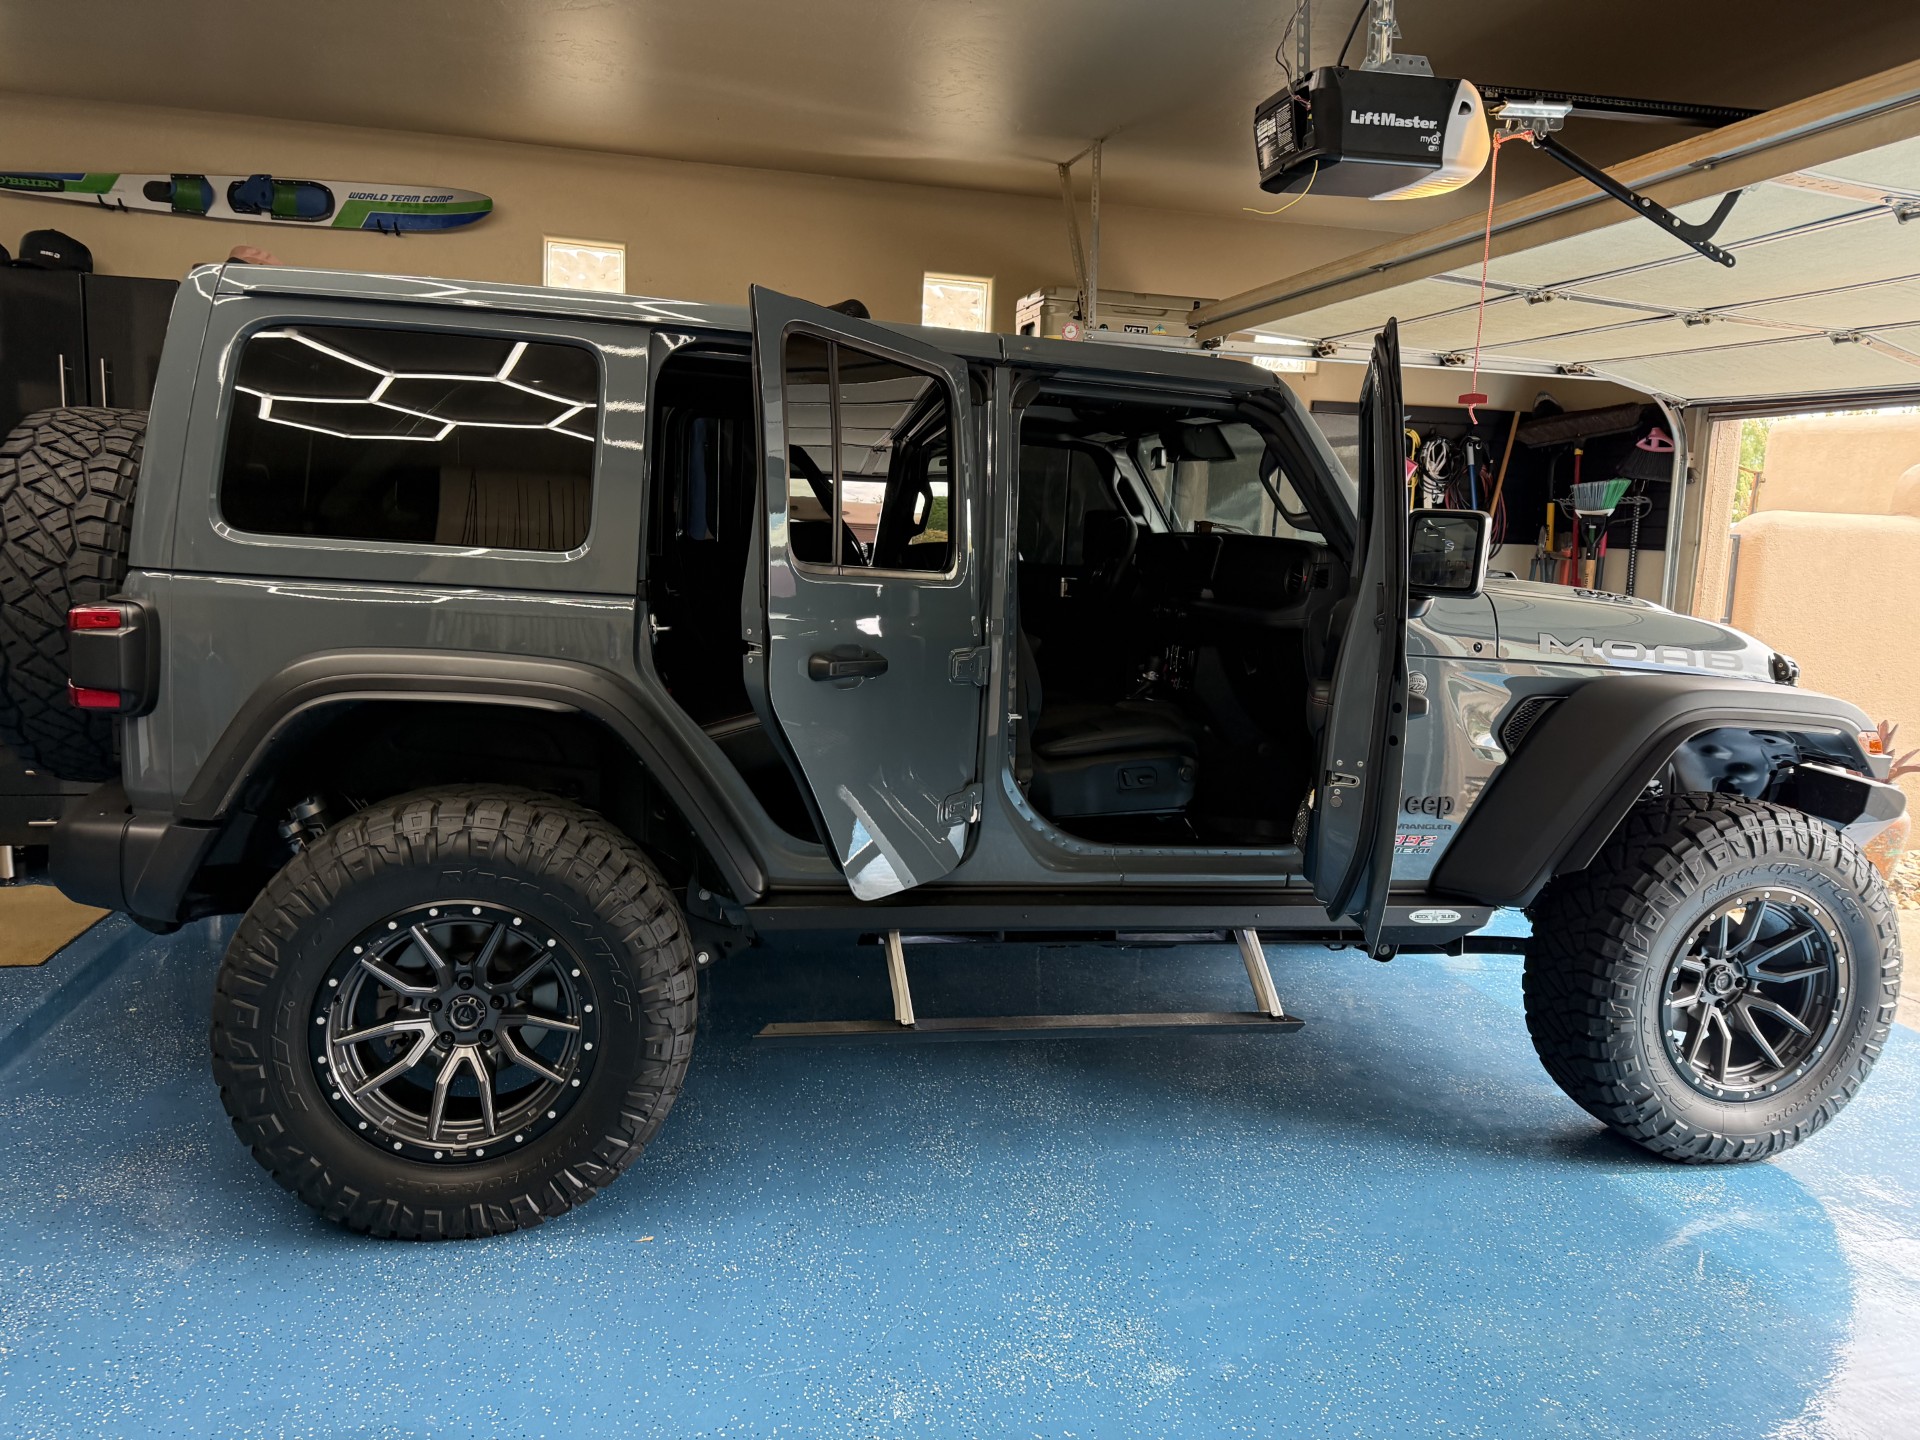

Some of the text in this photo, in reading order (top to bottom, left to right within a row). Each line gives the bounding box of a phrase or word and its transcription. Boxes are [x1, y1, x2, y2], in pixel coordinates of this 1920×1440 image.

[1350, 109, 1437, 129] LiftMaster
[348, 191, 454, 203] WORLD TEAM COMP
[1125, 326, 1148, 334] YETI
[1538, 632, 1744, 672] MOAB
